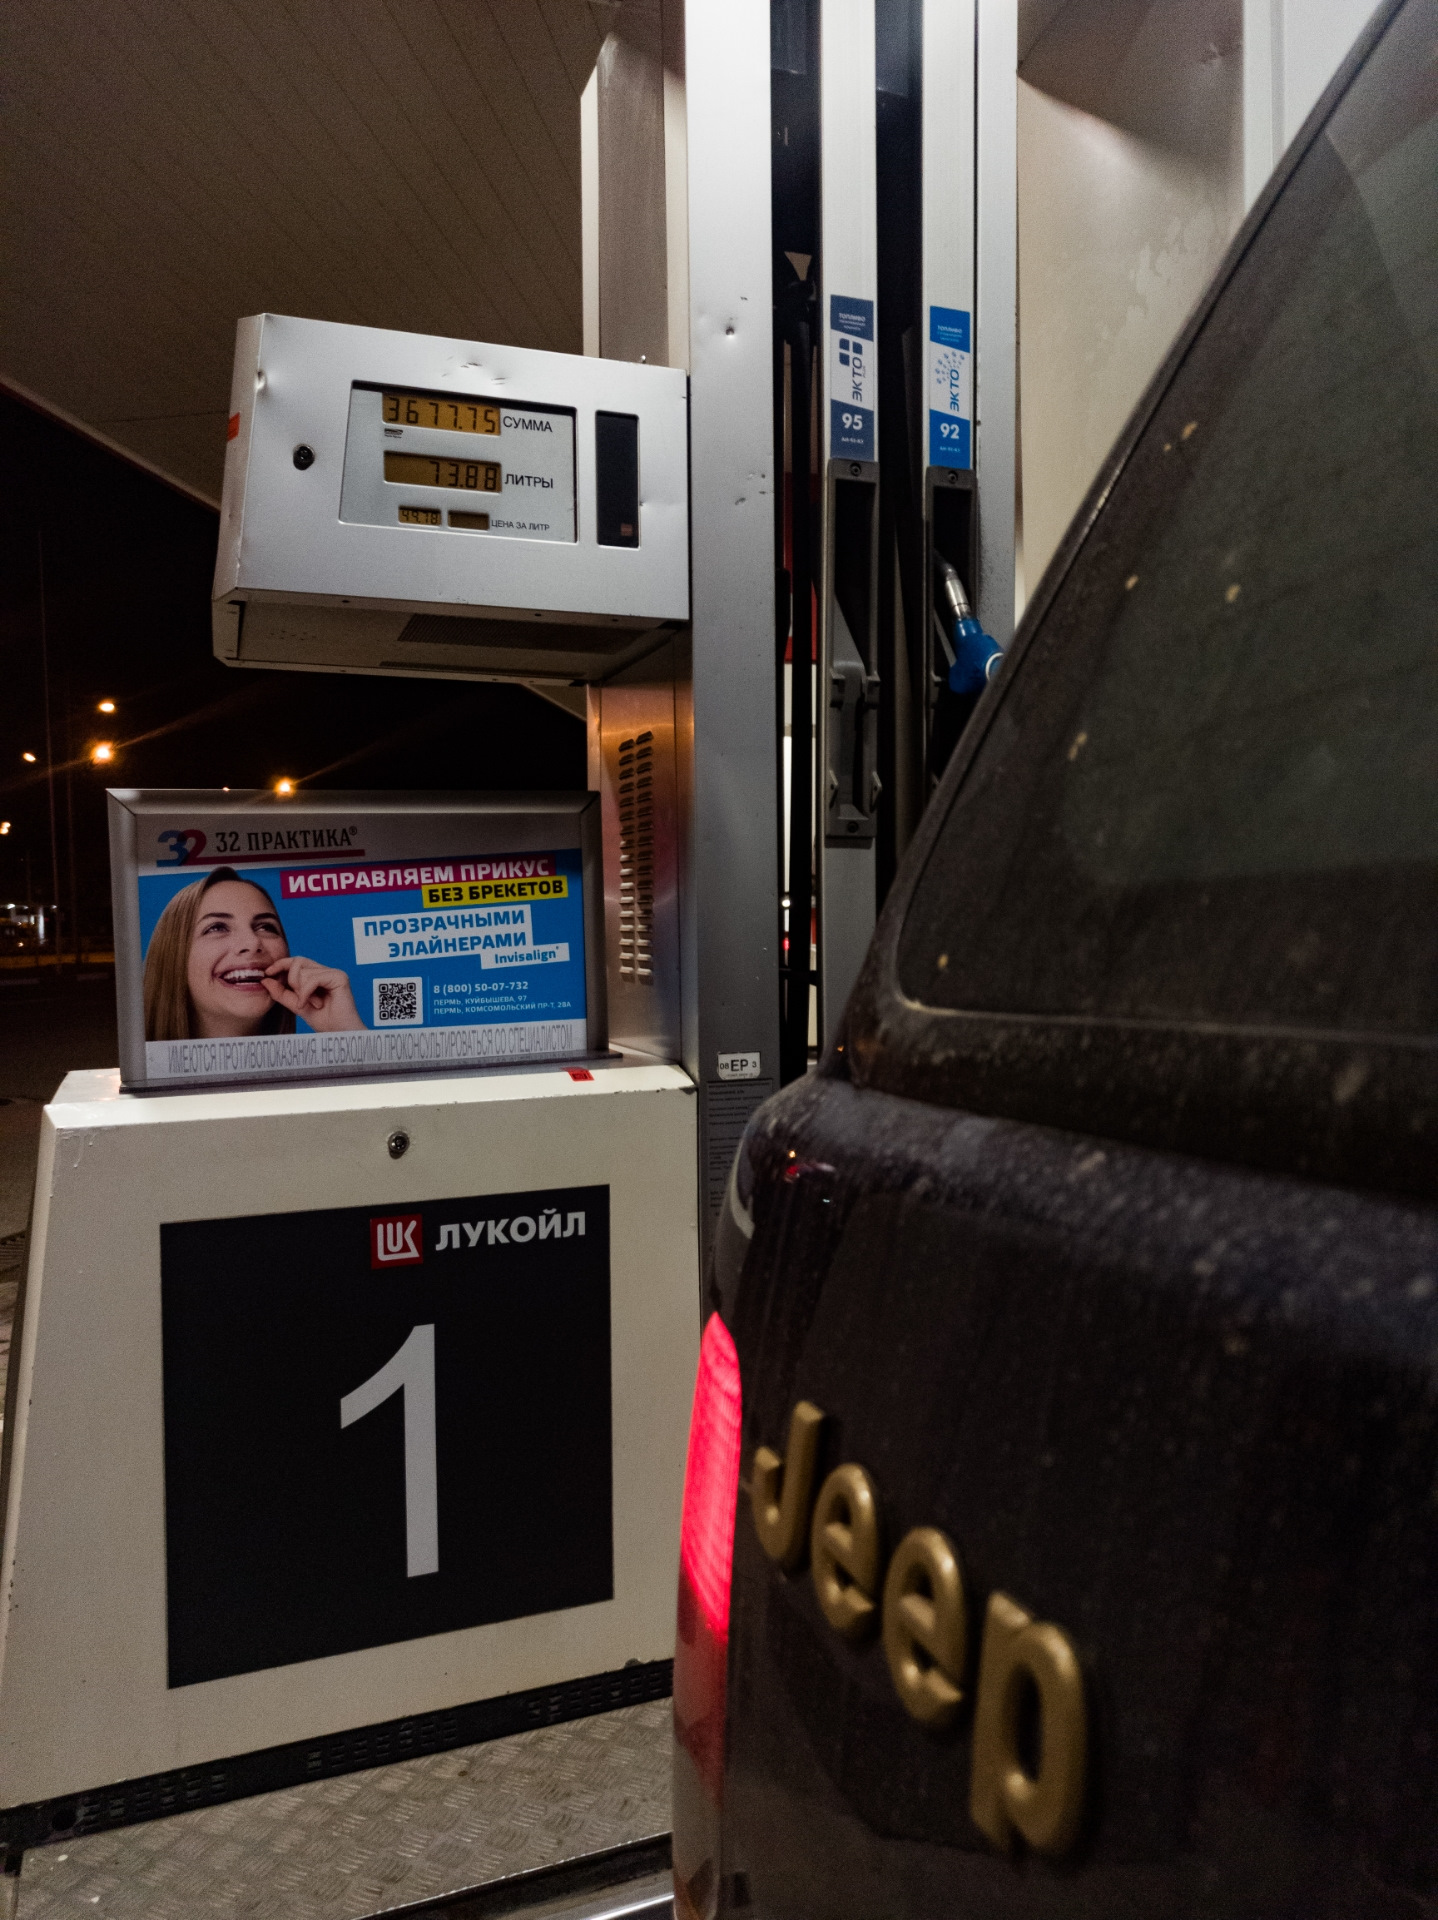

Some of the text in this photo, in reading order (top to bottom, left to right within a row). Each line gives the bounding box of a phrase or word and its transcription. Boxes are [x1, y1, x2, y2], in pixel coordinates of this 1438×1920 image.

[852, 356, 862, 402] ЭКТО
[950, 368, 960, 412] ЭКТО
[388, 397, 496, 433] 3677.75
[502, 415, 553, 433] СУММА
[841, 412, 863, 430] 95
[940, 422, 960, 440] 92
[429, 460, 498, 490] 73.88
[504, 473, 554, 489] ЛИТРЫ
[491, 519, 550, 531] ЦЕНА ЗА ЛИТР
[215, 831, 241, 852] 32
[289, 858, 549, 893] ИСПРАВЛЯЕМ ПРИКУС
[428, 879, 564, 904] БЕЗ БРЕКЕТОВ
[364, 909, 525, 938] ПРОЗРАЧНЫМИ
[388, 931, 527, 959] ЭЛАЙНЕРАМИ
[433, 981, 529, 997] 8 (800) 50-07-732
[433, 998, 464, 1007] ПЕРМЬ,
[433, 1007, 464, 1016] ПЕРМЬ,
[465, 1002, 536, 1014] КОМСОМОЛЬСКИЙ
[168, 1024, 573, 1074] ИМЕЮТСЯ ПРОТИВОПОКАЗАНИЯ. НЕОБХОДИМО ПРОКОНСУЛЬТИРОВАТЬСЯ СО СПЕЦИАЛИСТОМ
[435, 1207, 587, 1252] ЛУКОЙЛ
[340, 1323, 440, 1578] 1
[751, 1400, 1088, 1850] Jeep
